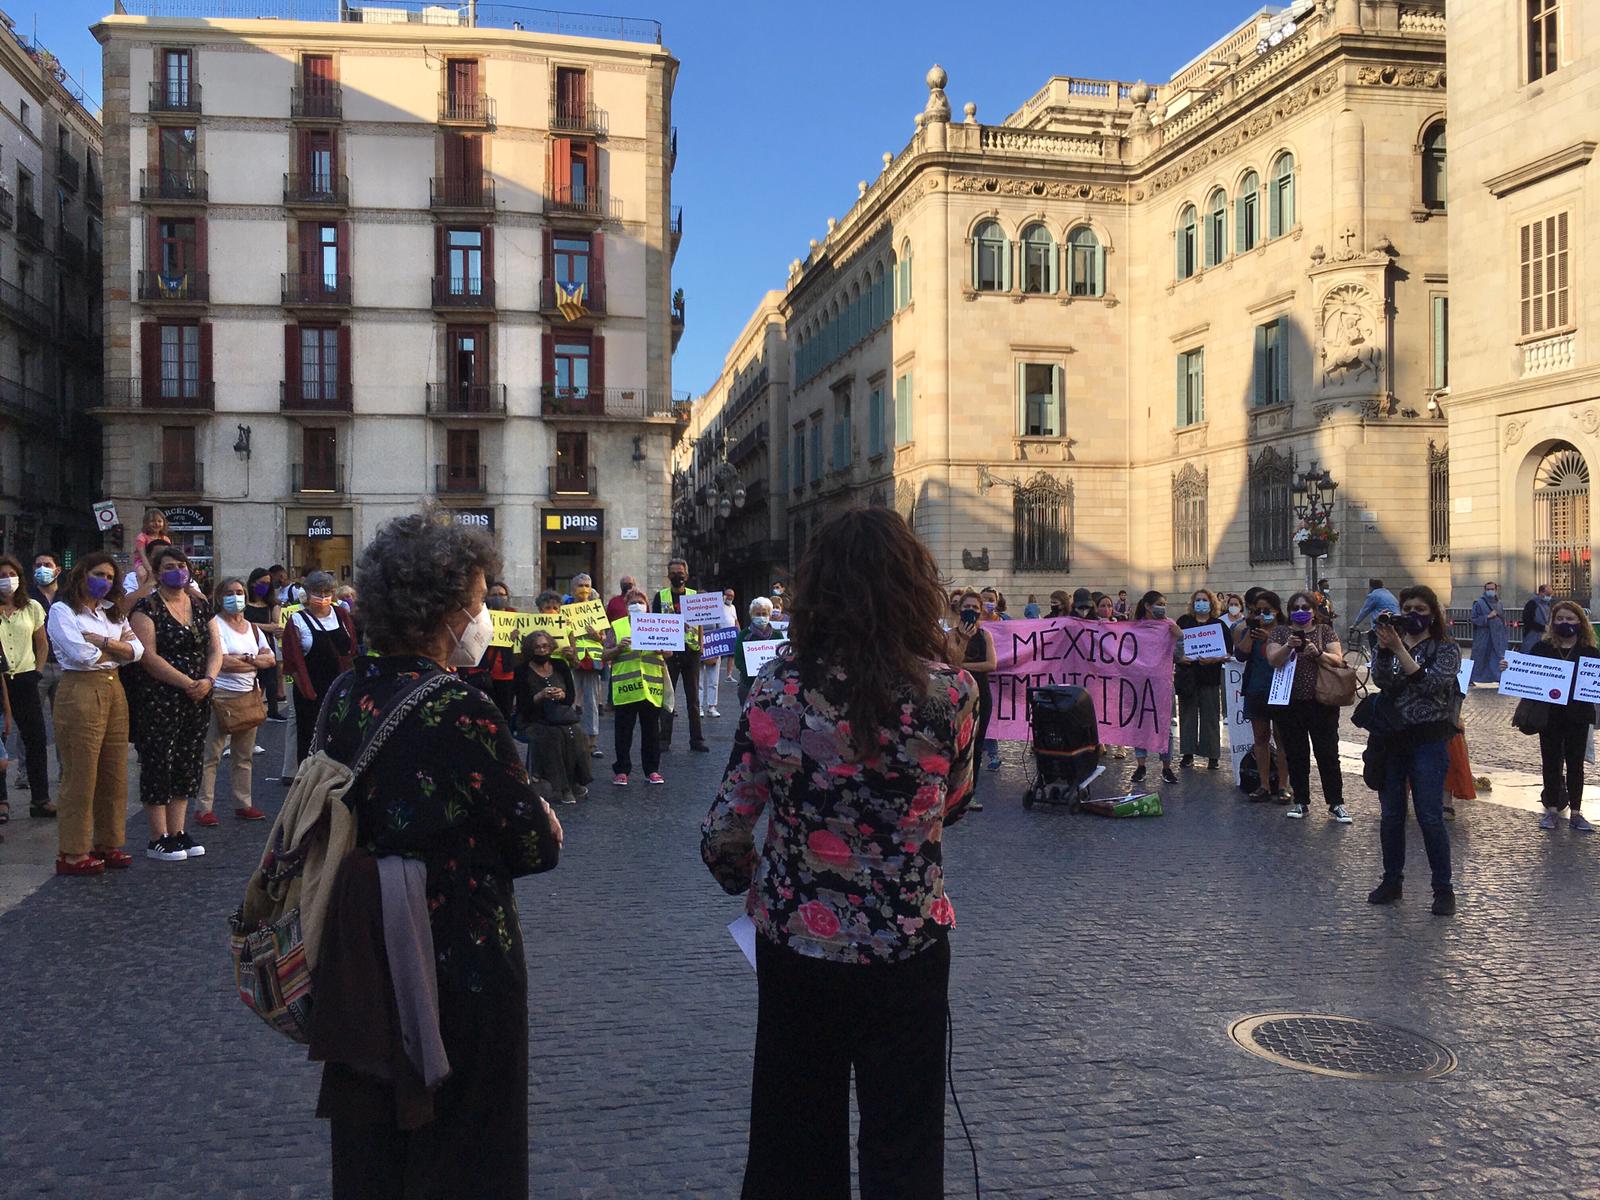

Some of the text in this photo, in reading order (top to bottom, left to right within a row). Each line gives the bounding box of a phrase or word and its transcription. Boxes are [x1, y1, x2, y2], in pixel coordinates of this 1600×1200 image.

[165, 508, 204, 523] RCELONA
[563, 515, 598, 530] pans
[308, 528, 332, 537] pans
[575, 604, 592, 615] UNA
[534, 617, 554, 626] UNA
[1013, 621, 1138, 666] MÉXICO
